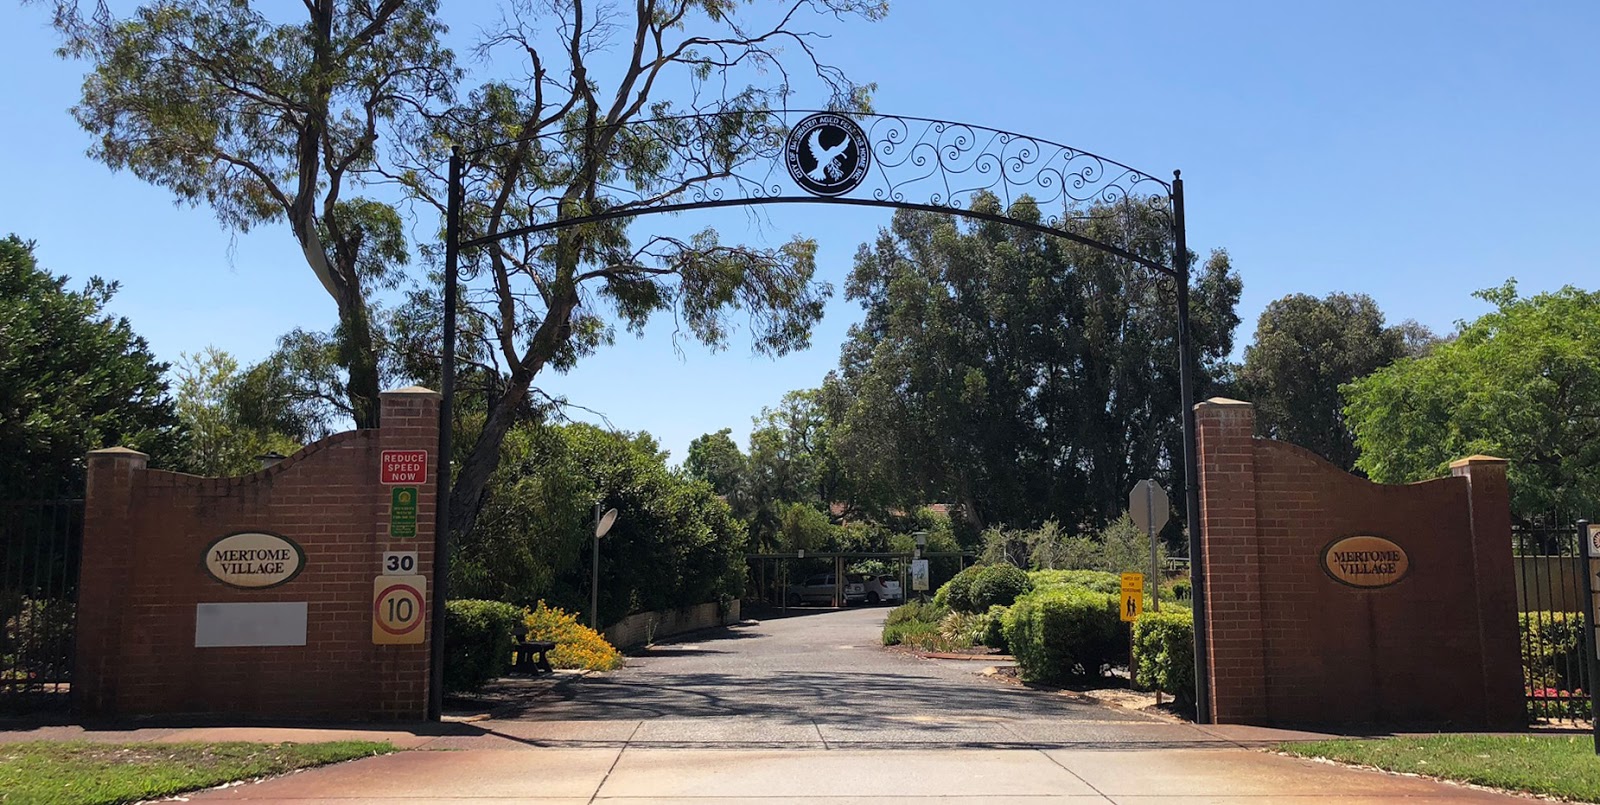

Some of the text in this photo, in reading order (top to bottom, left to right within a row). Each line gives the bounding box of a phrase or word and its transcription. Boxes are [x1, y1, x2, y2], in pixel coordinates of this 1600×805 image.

[789, 153, 796, 162] OF
[791, 163, 803, 178] CITY
[384, 454, 424, 463] REDUCE
[388, 463, 420, 472] SPEED
[392, 473, 416, 481] NOW
[215, 549, 291, 562] MERTOME
[1334, 551, 1400, 563] MERTOME
[221, 562, 285, 575] VILLAGE
[387, 555, 414, 571] 30
[1340, 563, 1397, 575] VILLAGE
[388, 597, 413, 622] 10
